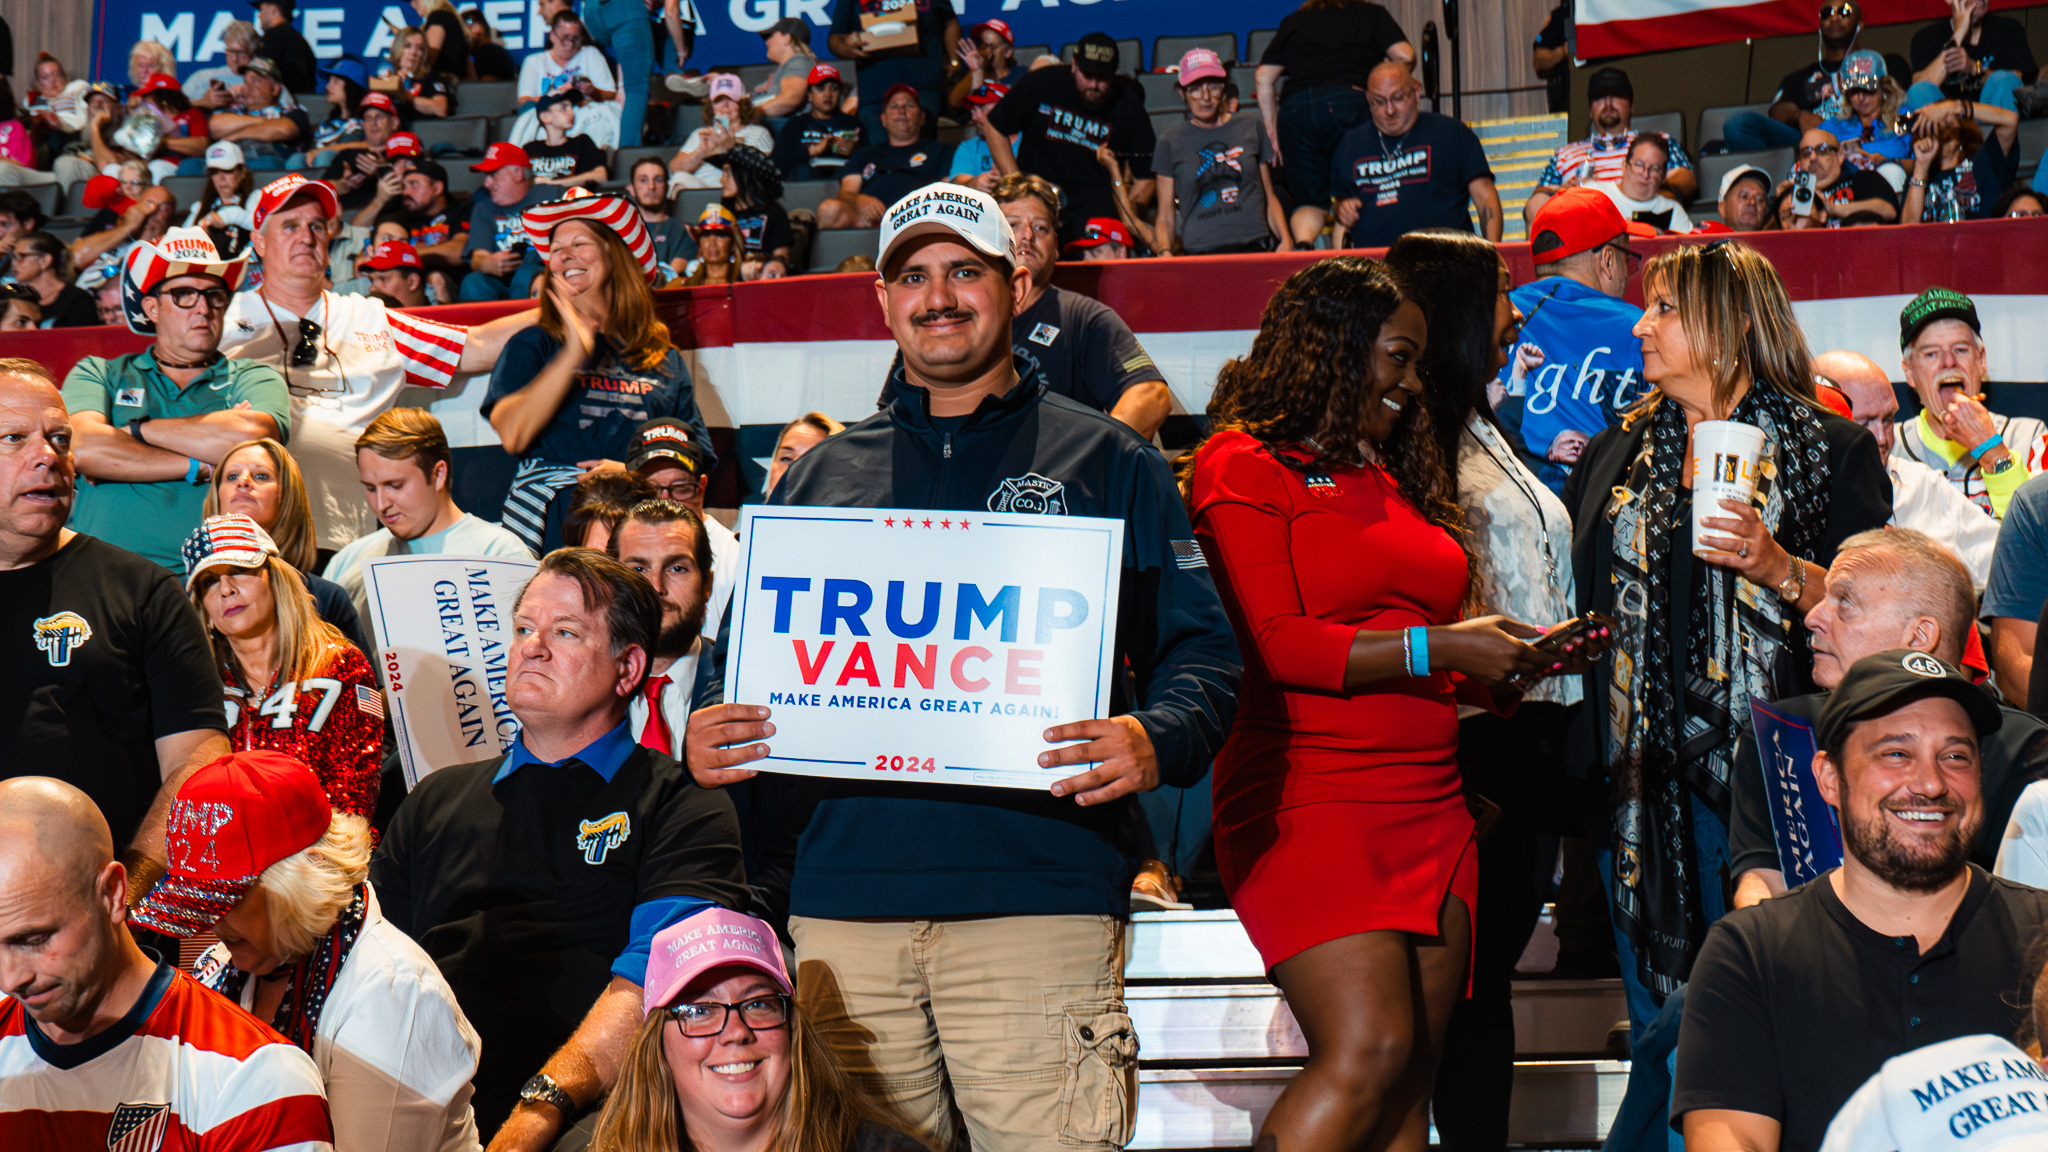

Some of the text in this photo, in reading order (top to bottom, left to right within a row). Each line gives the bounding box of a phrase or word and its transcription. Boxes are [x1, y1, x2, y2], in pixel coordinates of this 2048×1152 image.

[139, 8, 345, 62] MAE
[1054, 109, 1109, 138] TRUMP
[1356, 150, 1427, 177] TRUMP
[890, 191, 985, 221] MAKE AMERICA
[893, 203, 980, 230] GREAT AGAIN
[164, 238, 215, 253] TRUMP
[174, 249, 207, 259] 2024
[1927, 289, 1973, 306] AMERICA
[576, 375, 653, 395] TRUMP
[1526, 346, 1637, 415] ght
[642, 426, 688, 442] TRUMP
[1016, 478, 1052, 490] MASTIC
[464, 567, 500, 633] MAKE
[760, 576, 1090, 645] TRUMP
[385, 652, 403, 692] 2024
[433, 580, 487, 748] GREAT AGAIN
[792, 638, 1045, 696] VANCE
[1911, 658, 1939, 674] 45
[769, 692, 1060, 719] MAKE AMERICA GREAT AGAIN!
[874, 754, 936, 773] 2024
[167, 796, 233, 836] UMP
[1773, 730, 1806, 886] MERICA
[166, 834, 221, 873] 024
[666, 923, 766, 957] MAKE AMERICA
[675, 938, 761, 968] GREAT AGAIN
[1910, 1060, 1999, 1113] MAKE
[1949, 1090, 2040, 1139] GREAT
